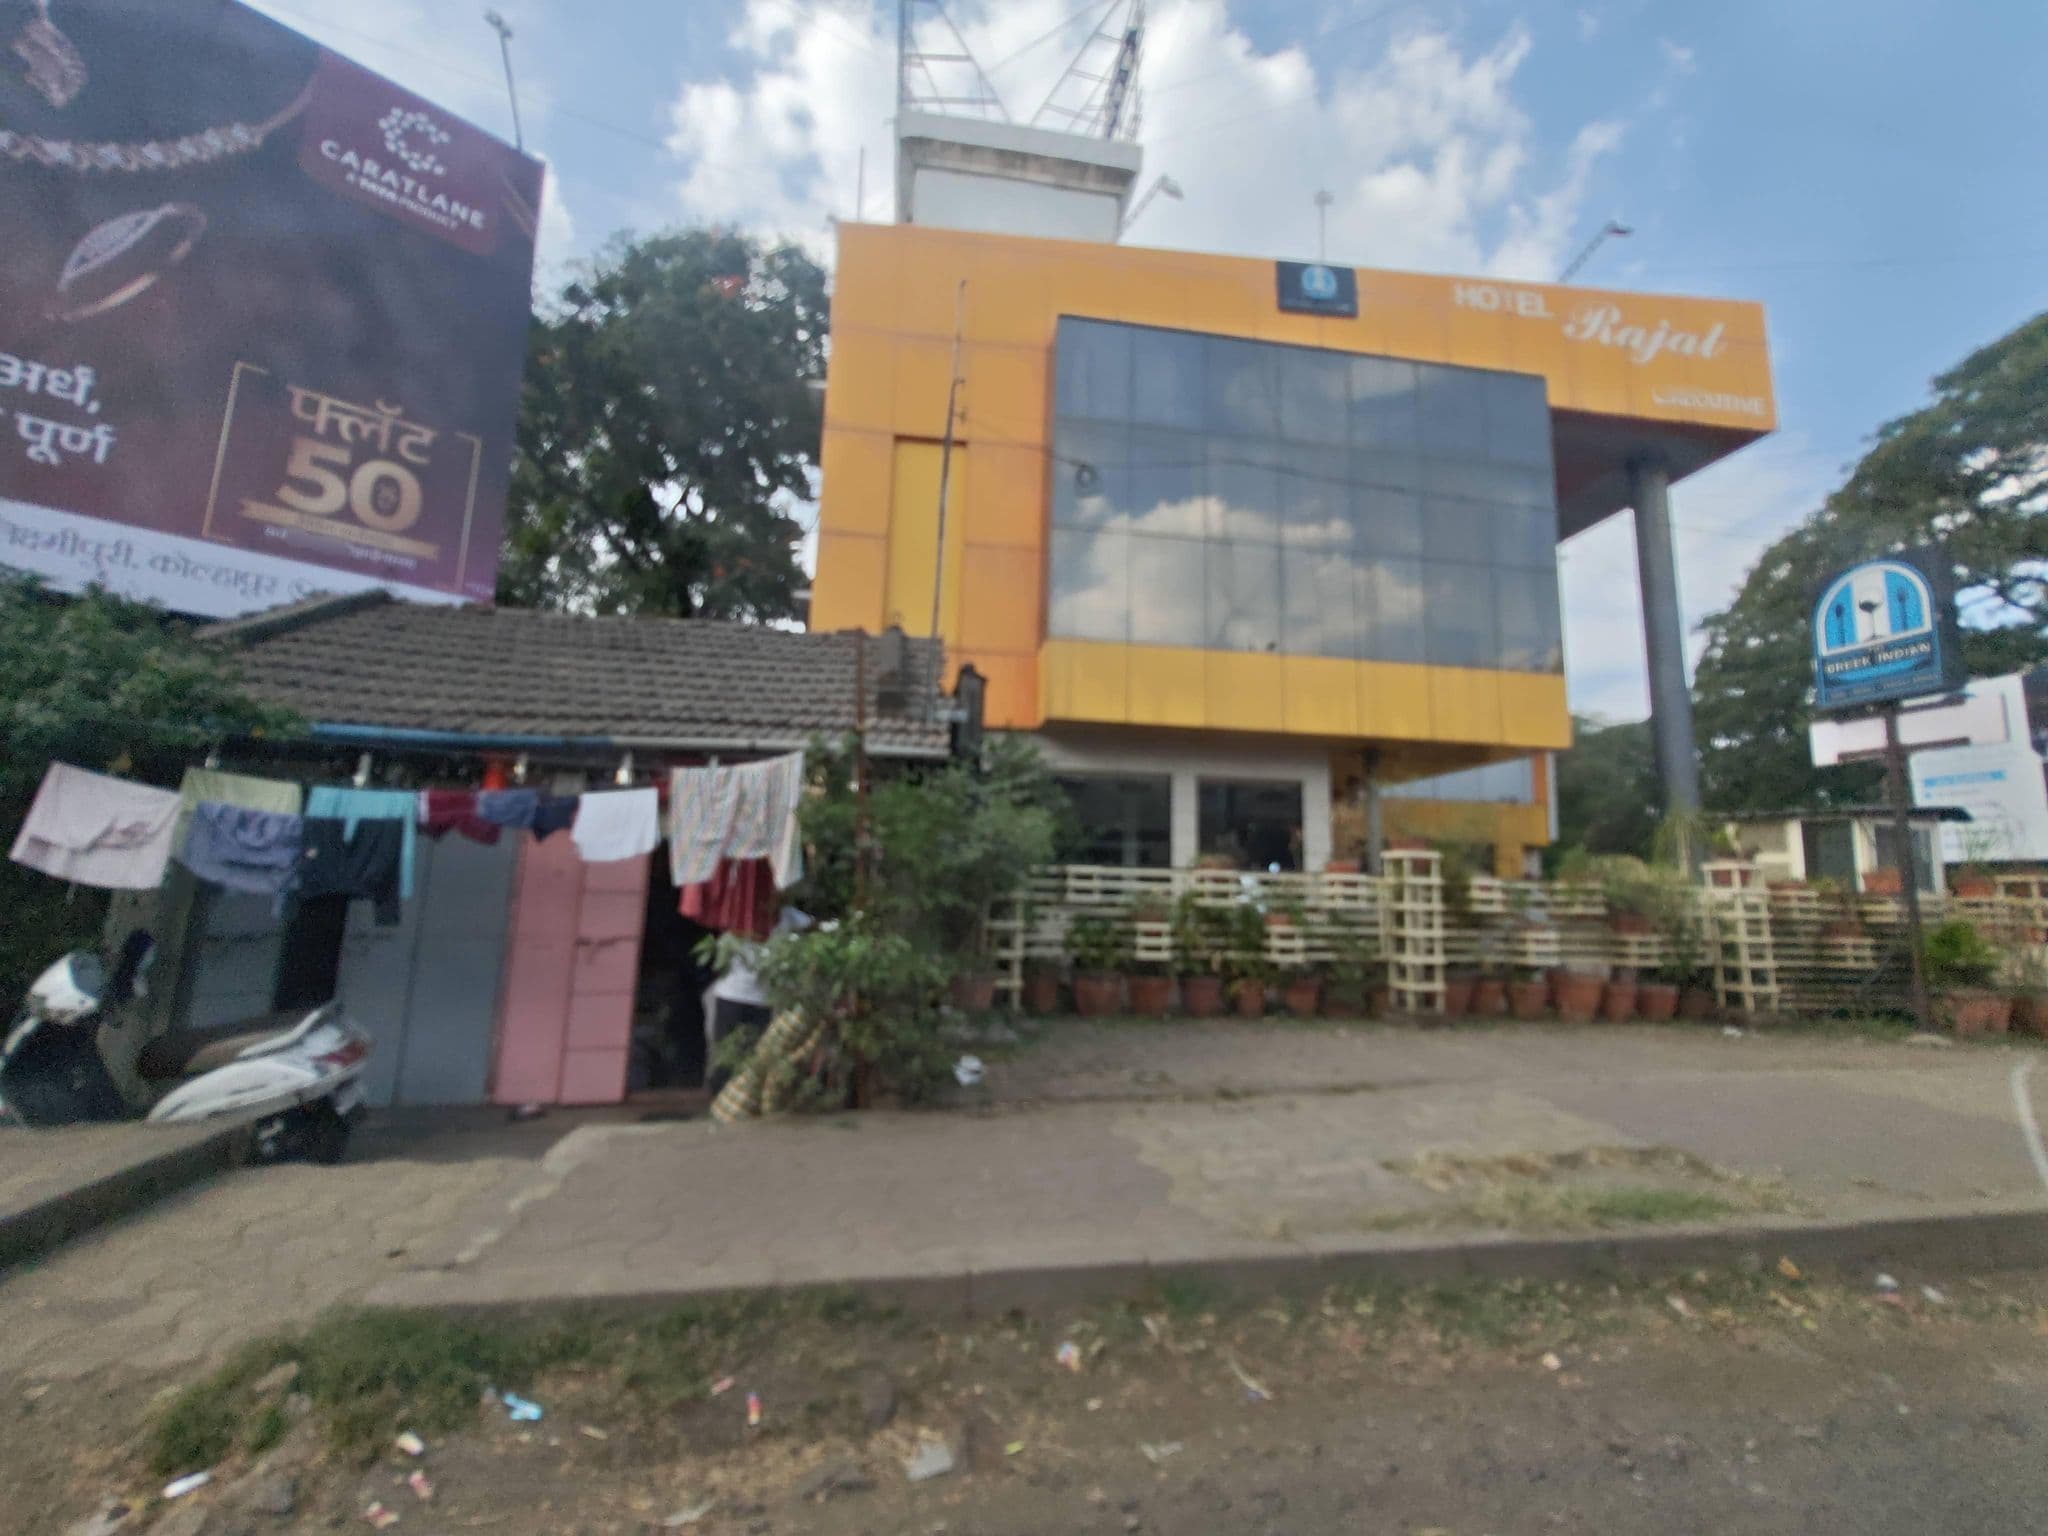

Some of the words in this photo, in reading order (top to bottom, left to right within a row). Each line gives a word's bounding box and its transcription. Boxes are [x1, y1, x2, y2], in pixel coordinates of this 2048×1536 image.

[320, 139, 484, 231] CARATLANE
[1455, 284, 1553, 319] HOTEL
[1562, 303, 1727, 364] Rajat
[275, 436, 424, 532] 50
